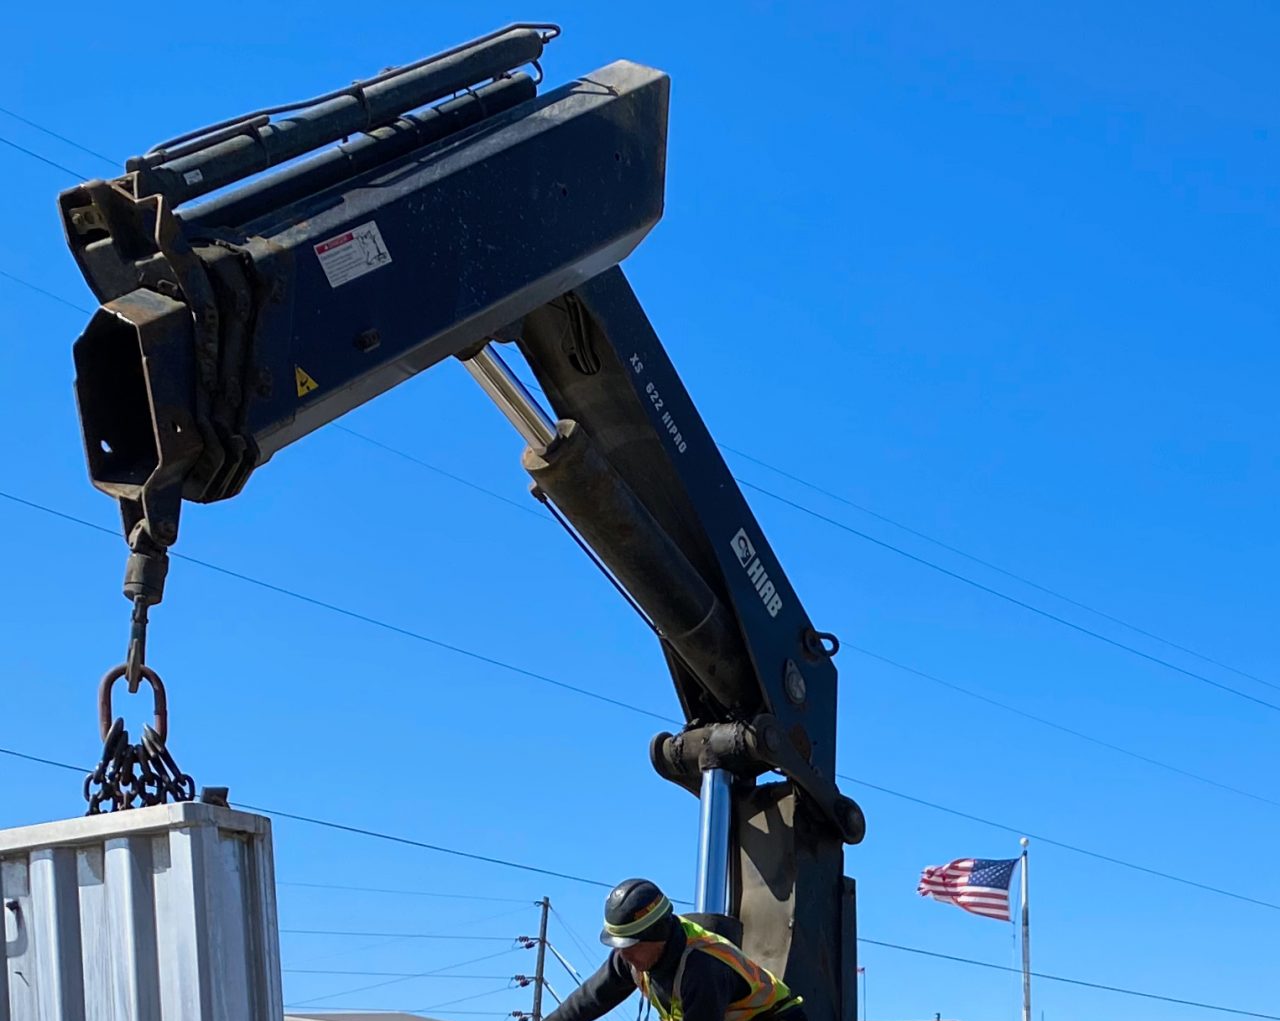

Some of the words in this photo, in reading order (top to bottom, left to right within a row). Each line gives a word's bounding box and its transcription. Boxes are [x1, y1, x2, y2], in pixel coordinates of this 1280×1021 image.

[630, 353, 643, 374] XS
[646, 382, 664, 411] 622
[662, 411, 687, 453] HIPRO
[747, 558, 783, 618] HIAB
